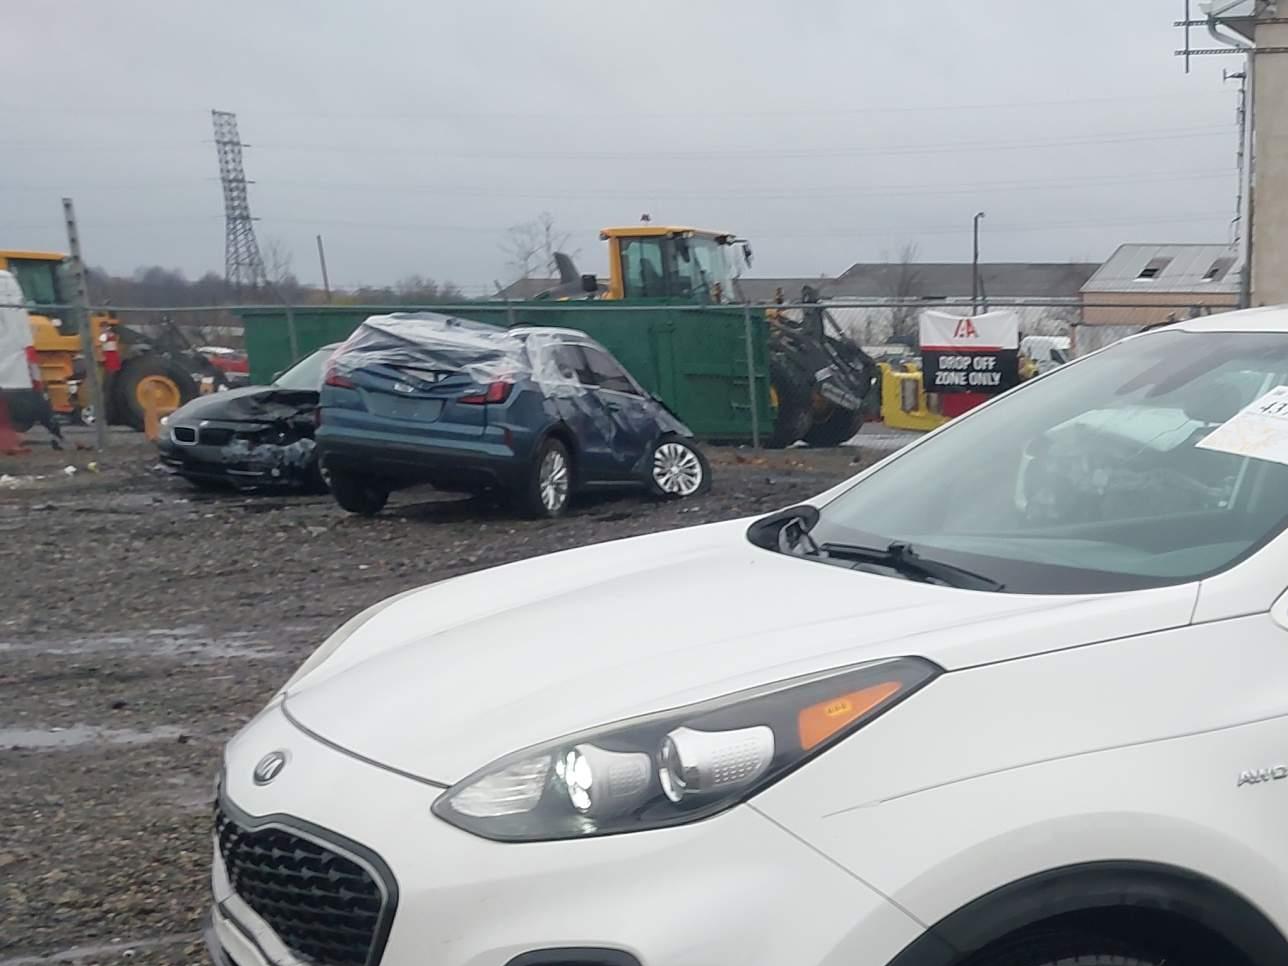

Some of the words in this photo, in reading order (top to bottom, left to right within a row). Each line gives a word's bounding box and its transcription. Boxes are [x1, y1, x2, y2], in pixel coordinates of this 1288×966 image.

[939, 356, 972, 370] DROP
[972, 357, 997, 370] OFF
[935, 371, 968, 386] ZONE
[968, 372, 1002, 386] ONLY
